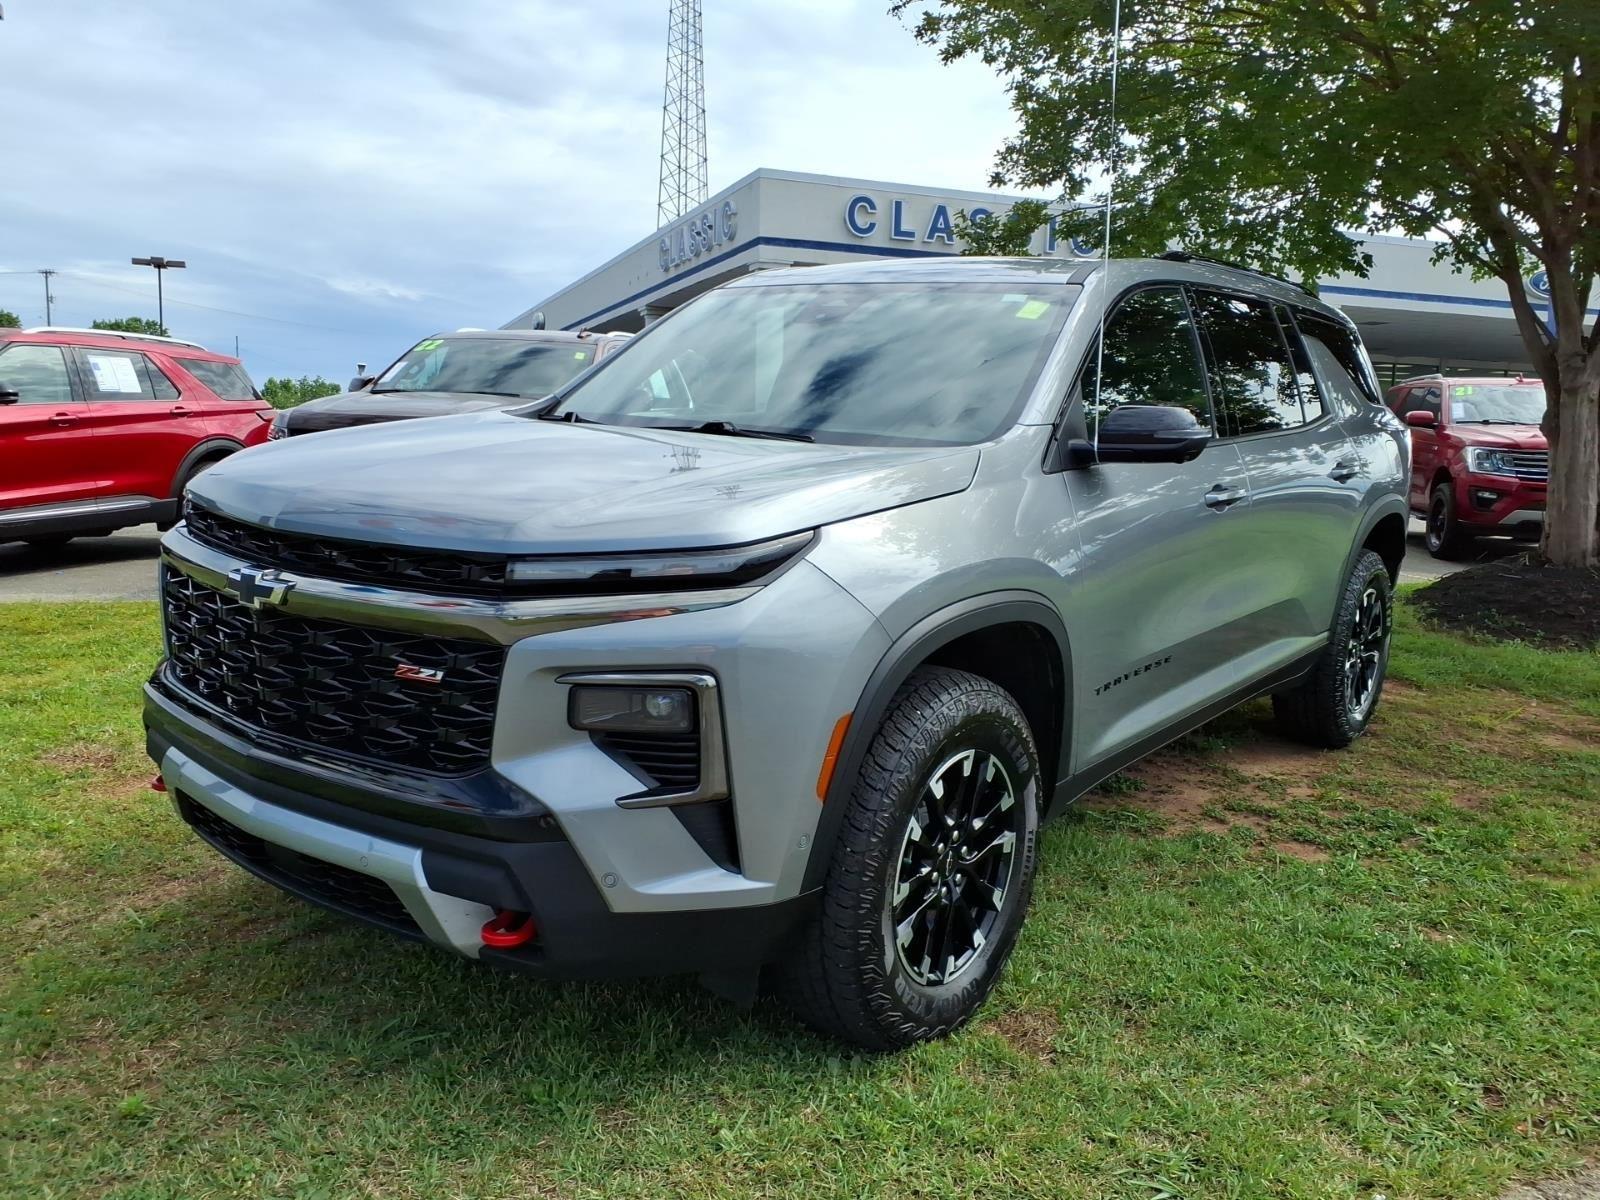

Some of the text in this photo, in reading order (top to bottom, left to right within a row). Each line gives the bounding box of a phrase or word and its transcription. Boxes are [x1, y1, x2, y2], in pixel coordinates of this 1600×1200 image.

[659, 200, 737, 273] CLASSIC
[845, 193, 1104, 257] CLAI
[413, 339, 445, 352] 22
[1455, 386, 1473, 396] 21
[394, 664, 444, 683] Z71
[1094, 655, 1172, 696] TRAVERSE
